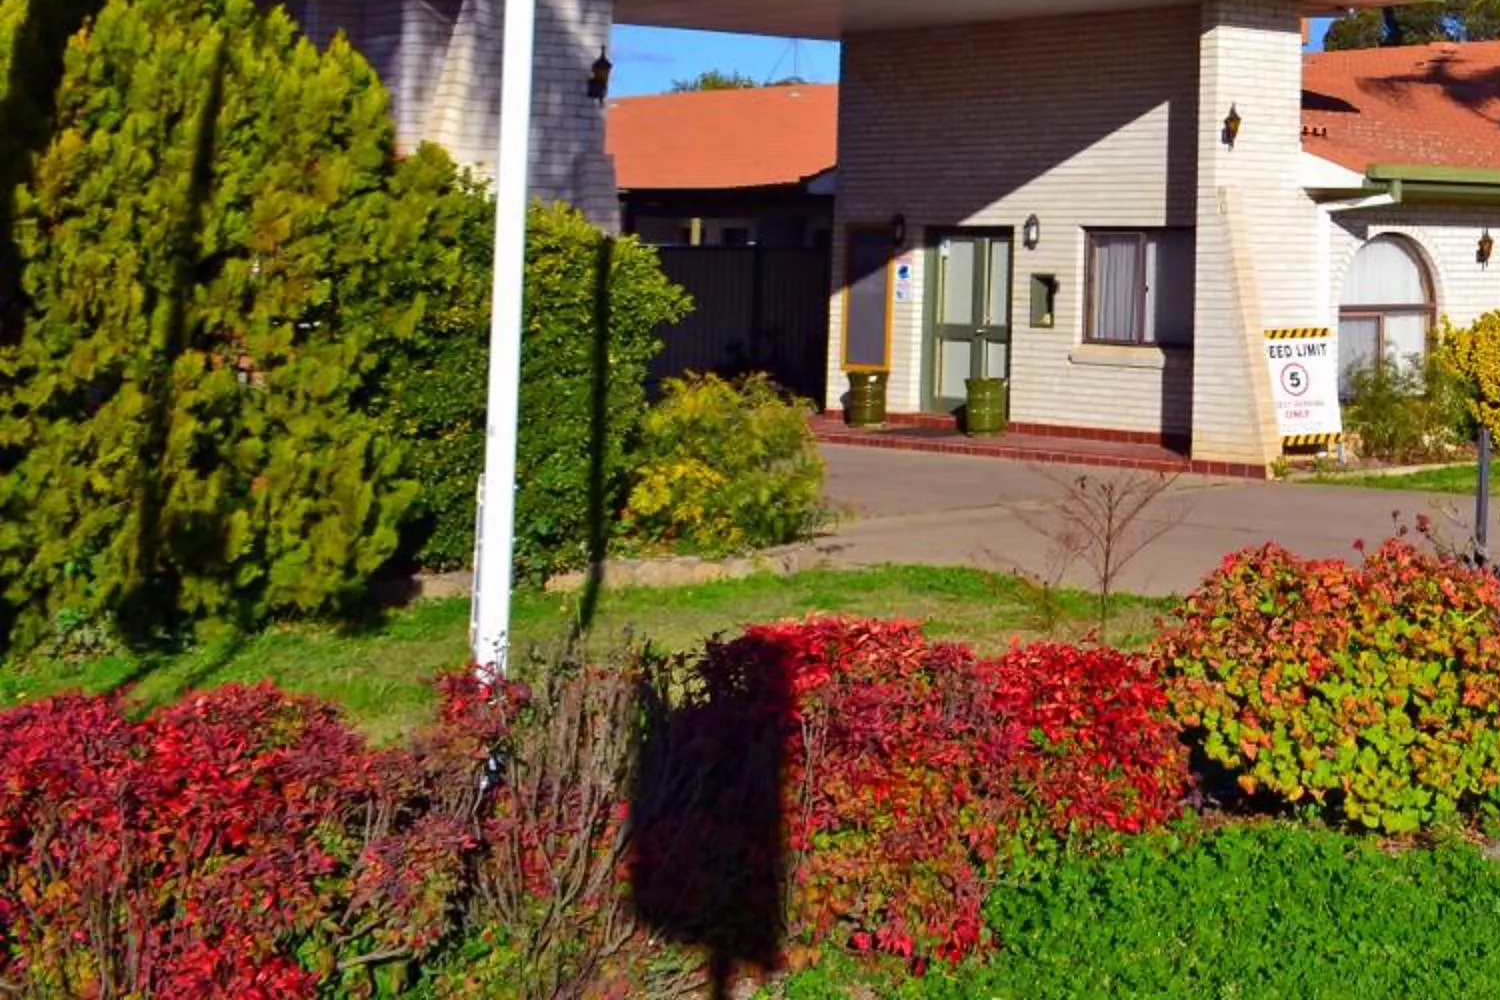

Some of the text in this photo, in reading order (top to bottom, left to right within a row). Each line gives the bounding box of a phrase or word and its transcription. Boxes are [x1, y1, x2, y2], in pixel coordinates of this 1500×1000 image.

[1266, 343, 1327, 359] EED LIMIT
[1289, 371, 1301, 388] 5
